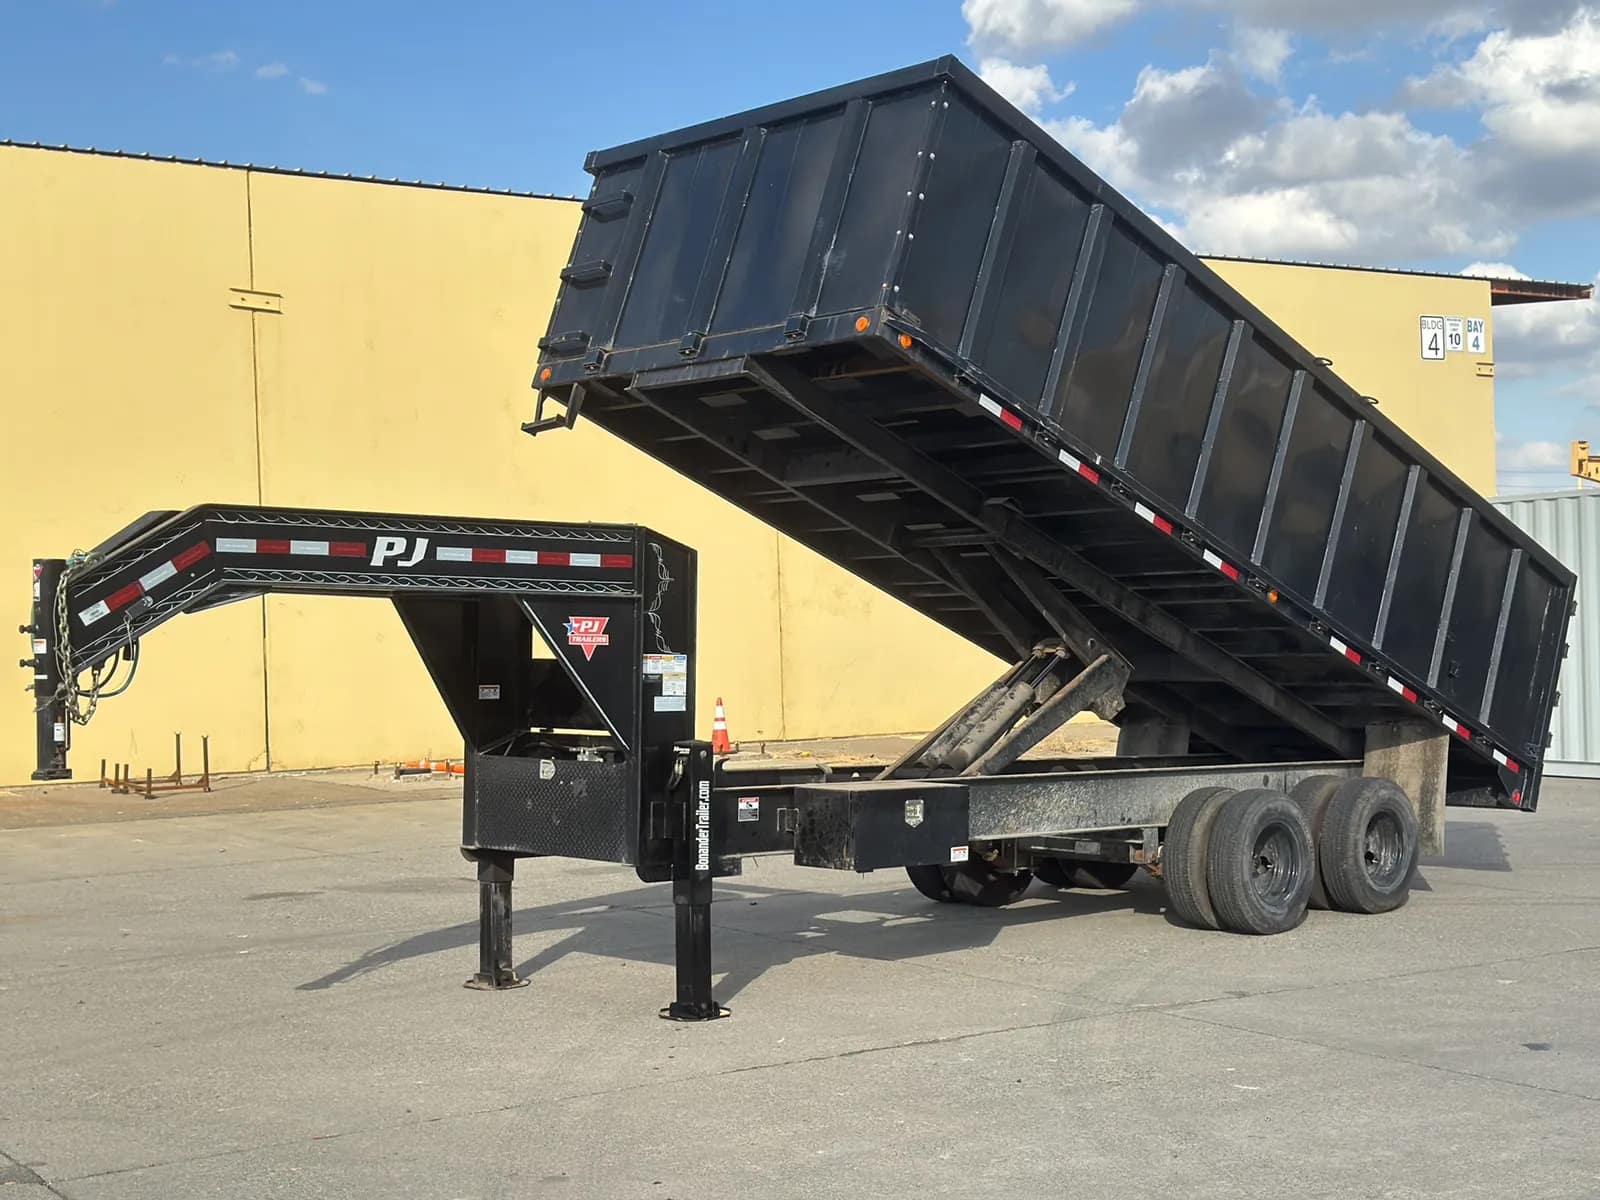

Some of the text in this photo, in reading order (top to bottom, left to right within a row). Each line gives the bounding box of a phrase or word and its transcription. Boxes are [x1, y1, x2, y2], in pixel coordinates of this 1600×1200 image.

[1420, 319, 1443, 330] BLDG
[1467, 320, 1484, 333] BAY
[1428, 332, 1441, 356] 4
[1448, 333, 1461, 346] 10
[1472, 335, 1481, 351] 4
[370, 536, 429, 567] PJ
[580, 620, 600, 633] PJ
[695, 780, 710, 871] BonanderTrailer.com
